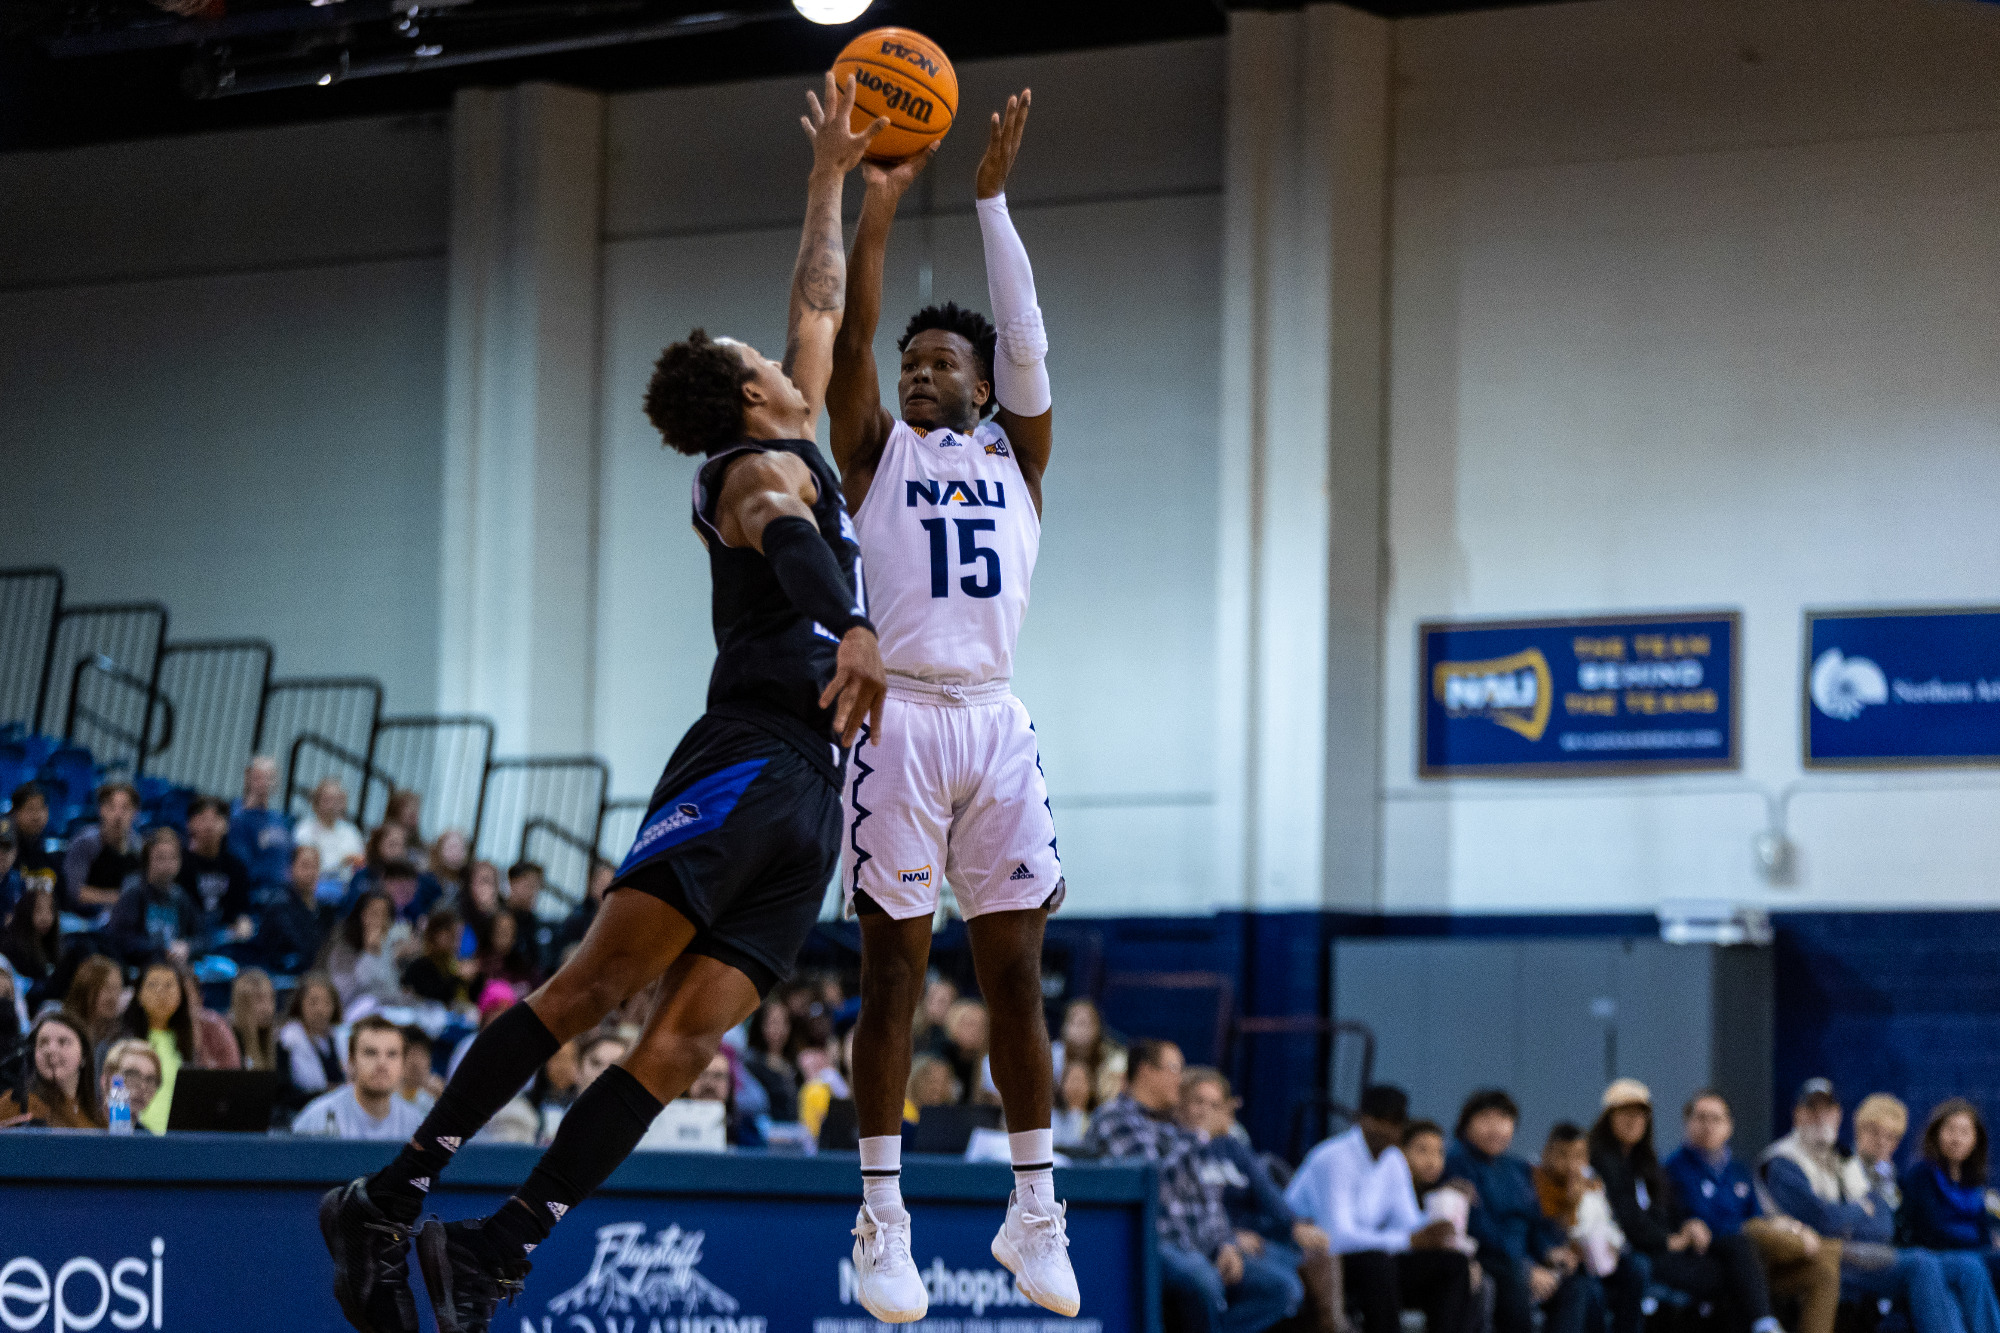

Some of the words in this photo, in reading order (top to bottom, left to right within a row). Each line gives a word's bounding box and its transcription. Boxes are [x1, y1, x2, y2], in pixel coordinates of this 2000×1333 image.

[881, 41, 939, 78] NCAA
[855, 67, 934, 124] Wilson
[906, 480, 1006, 509] NAU
[920, 518, 1002, 599] 15
[1445, 671, 1538, 709] NAU
[1577, 660, 1704, 690] BEHIND
[902, 872, 929, 882] NAU
[0, 1236, 165, 1333] epsi
